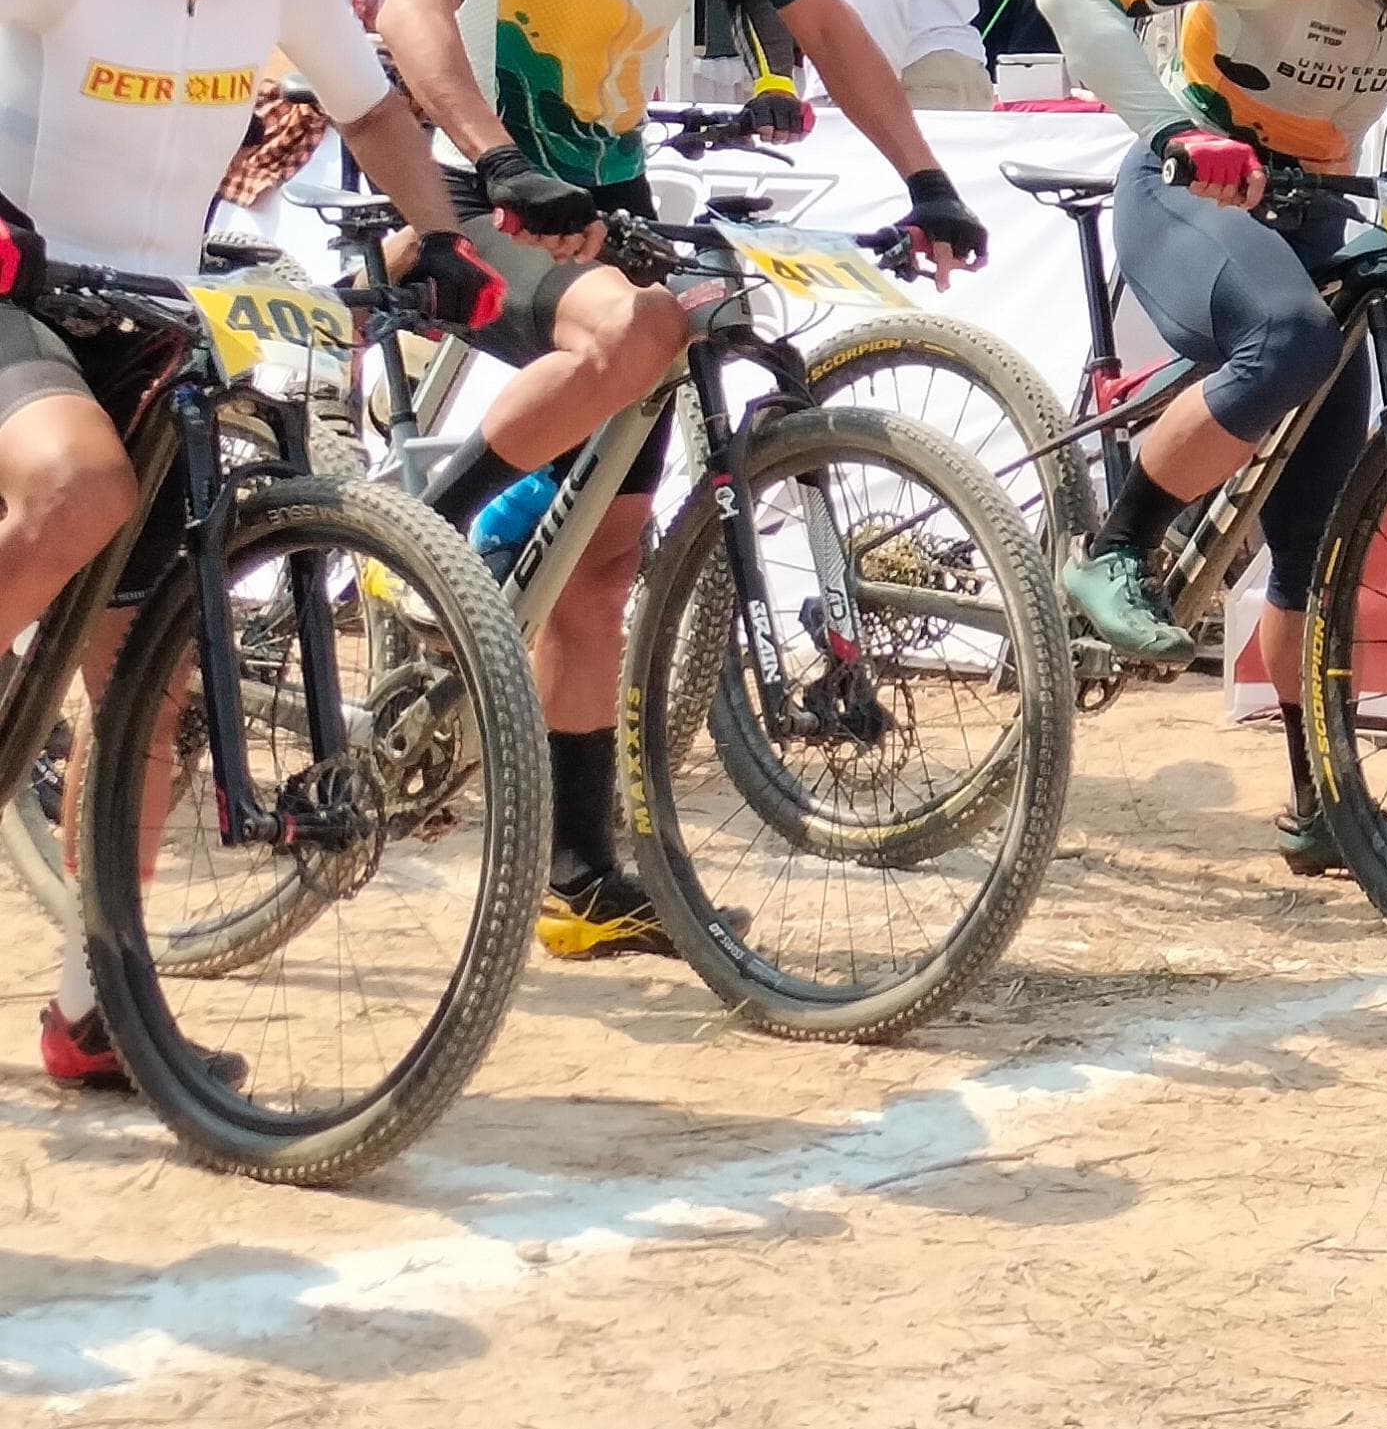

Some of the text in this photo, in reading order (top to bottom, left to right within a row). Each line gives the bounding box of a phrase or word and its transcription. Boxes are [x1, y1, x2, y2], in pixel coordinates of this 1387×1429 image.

[1277, 63, 1345, 91] BUDI
[809, 337, 901, 381] SCORPION
[750, 599, 783, 683] BRAIN
[1303, 616, 1332, 756] SCORPION
[624, 686, 654, 837] MAXXIS
[708, 922, 726, 937] DT
